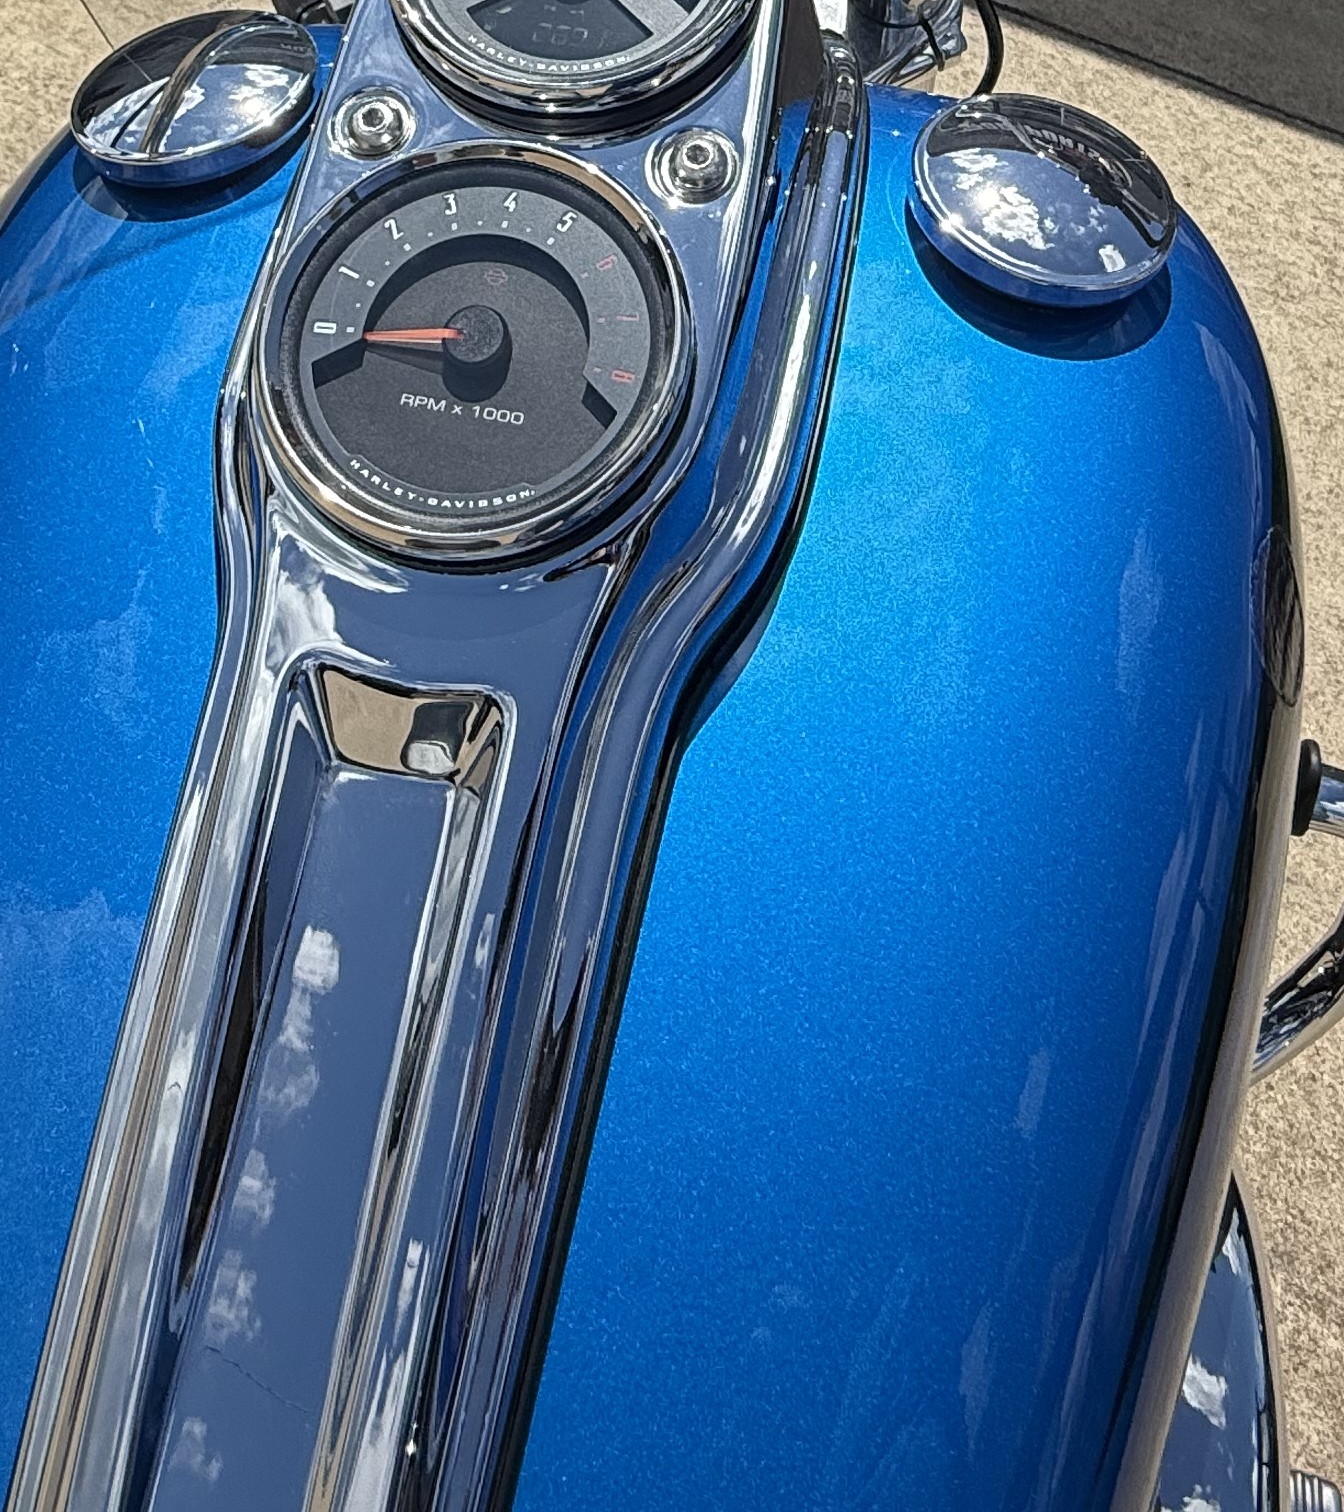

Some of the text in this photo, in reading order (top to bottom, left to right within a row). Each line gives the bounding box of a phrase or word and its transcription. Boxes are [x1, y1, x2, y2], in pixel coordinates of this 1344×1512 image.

[441, 194, 458, 216] 3
[502, 191, 518, 213] 4
[384, 219, 404, 241] 2
[557, 210, 578, 233] 5
[338, 264, 362, 281] 1
[313, 321, 337, 335] 0
[400, 393, 525, 425] RPM x 1000
[349, 459, 532, 509] HARLEY-DAVIDSON
